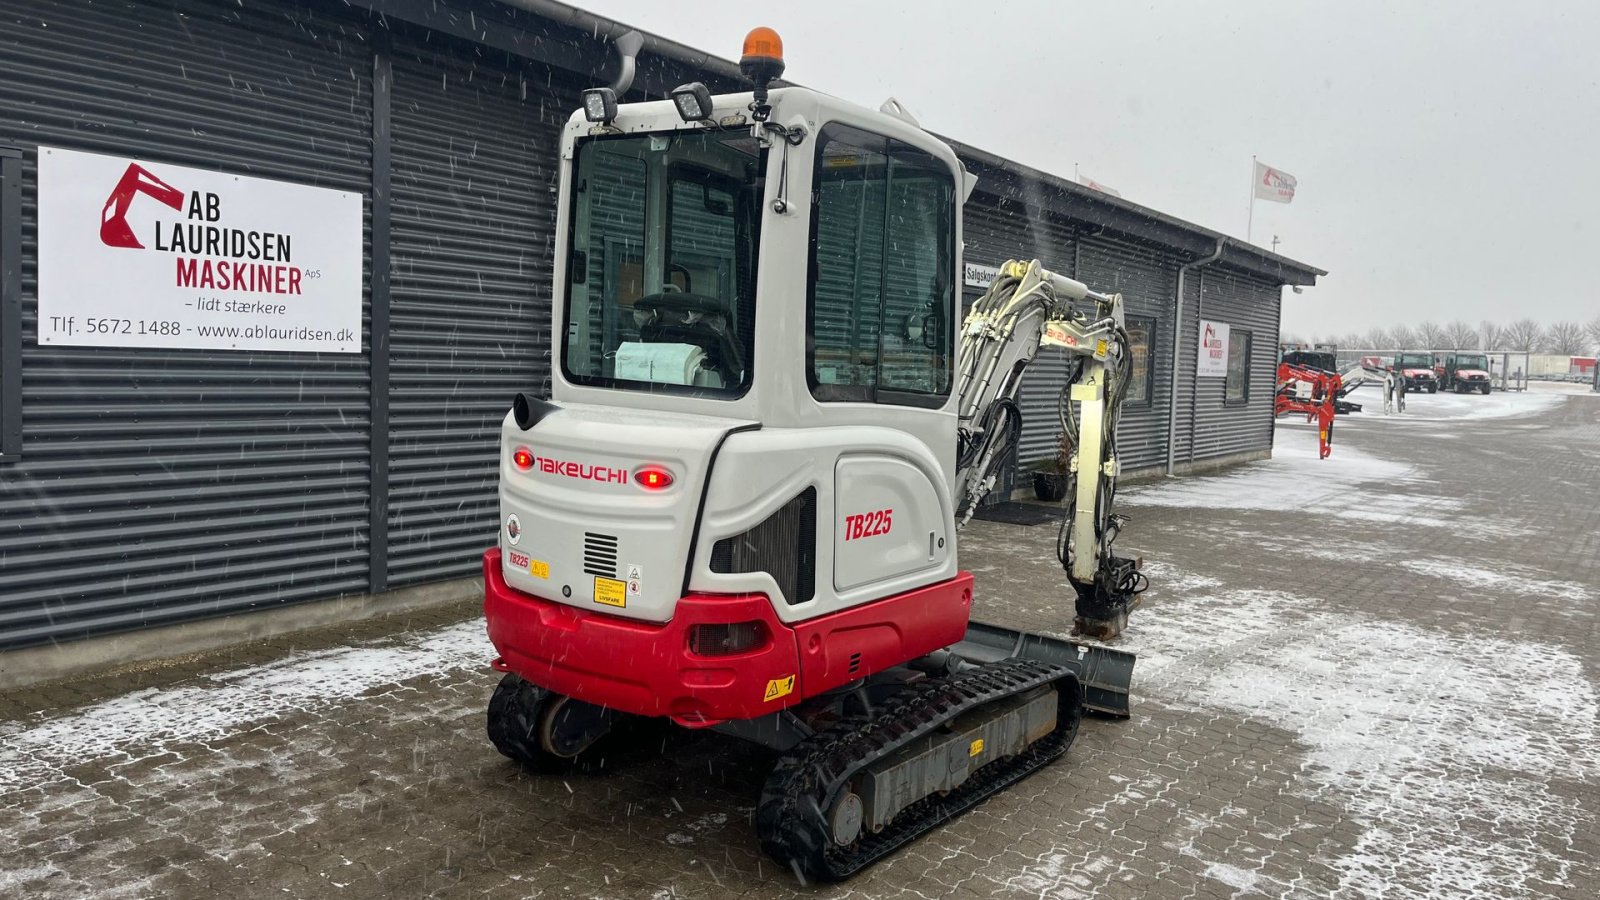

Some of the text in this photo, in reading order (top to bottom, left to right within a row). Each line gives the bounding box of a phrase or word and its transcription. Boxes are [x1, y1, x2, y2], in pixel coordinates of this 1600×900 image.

[188, 190, 221, 222] AB
[155, 220, 291, 263] LAURIDSEN
[176, 257, 321, 295] MASKINER ApS
[197, 297, 221, 312] lidt
[224, 300, 287, 315] stærkere
[50, 316, 80, 336] Tlf.
[87, 318, 132, 335] 5672
[138, 319, 181, 336] 1488
[197, 325, 354, 342] www.ablauridsen.dk
[845, 509, 893, 541] TB225
[509, 552, 529, 568] TB225
